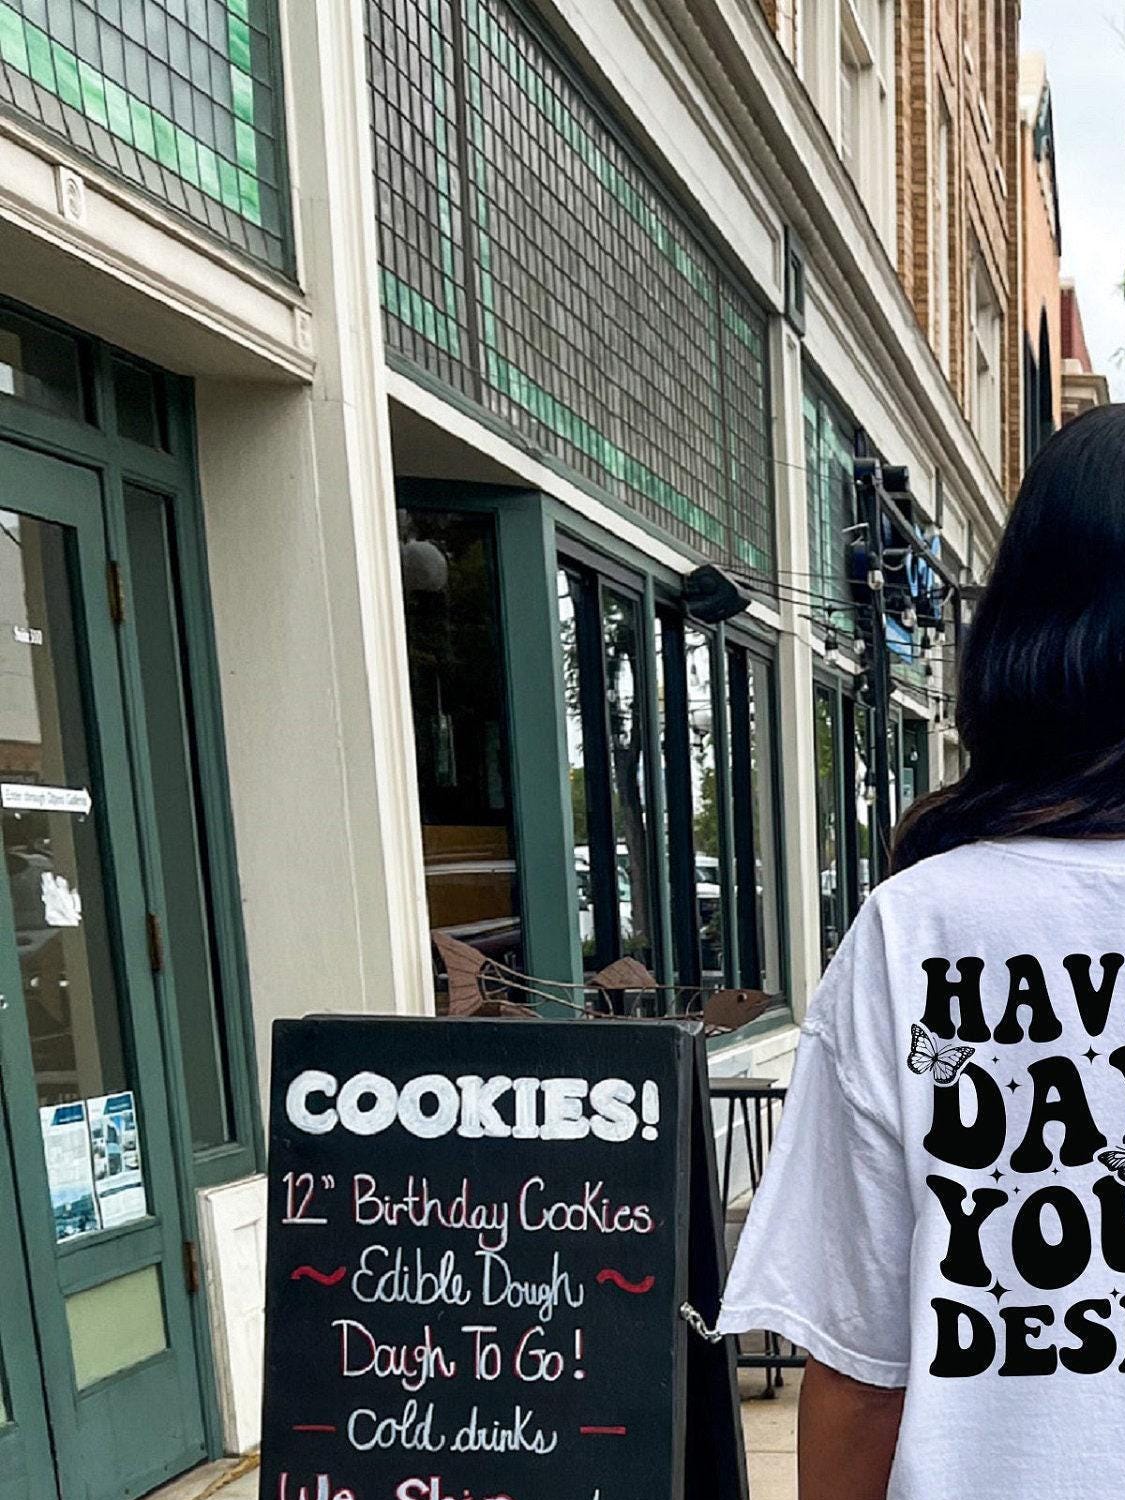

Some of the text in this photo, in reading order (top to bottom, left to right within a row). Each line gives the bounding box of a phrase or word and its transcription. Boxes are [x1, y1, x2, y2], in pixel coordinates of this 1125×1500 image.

[284, 1069, 660, 1143] COOKIES!
[353, 1174, 508, 1251] Birthday
[350, 1244, 584, 1322] Edible Dough
[461, 1325, 501, 1381] To
[347, 1399, 446, 1452] Cold
